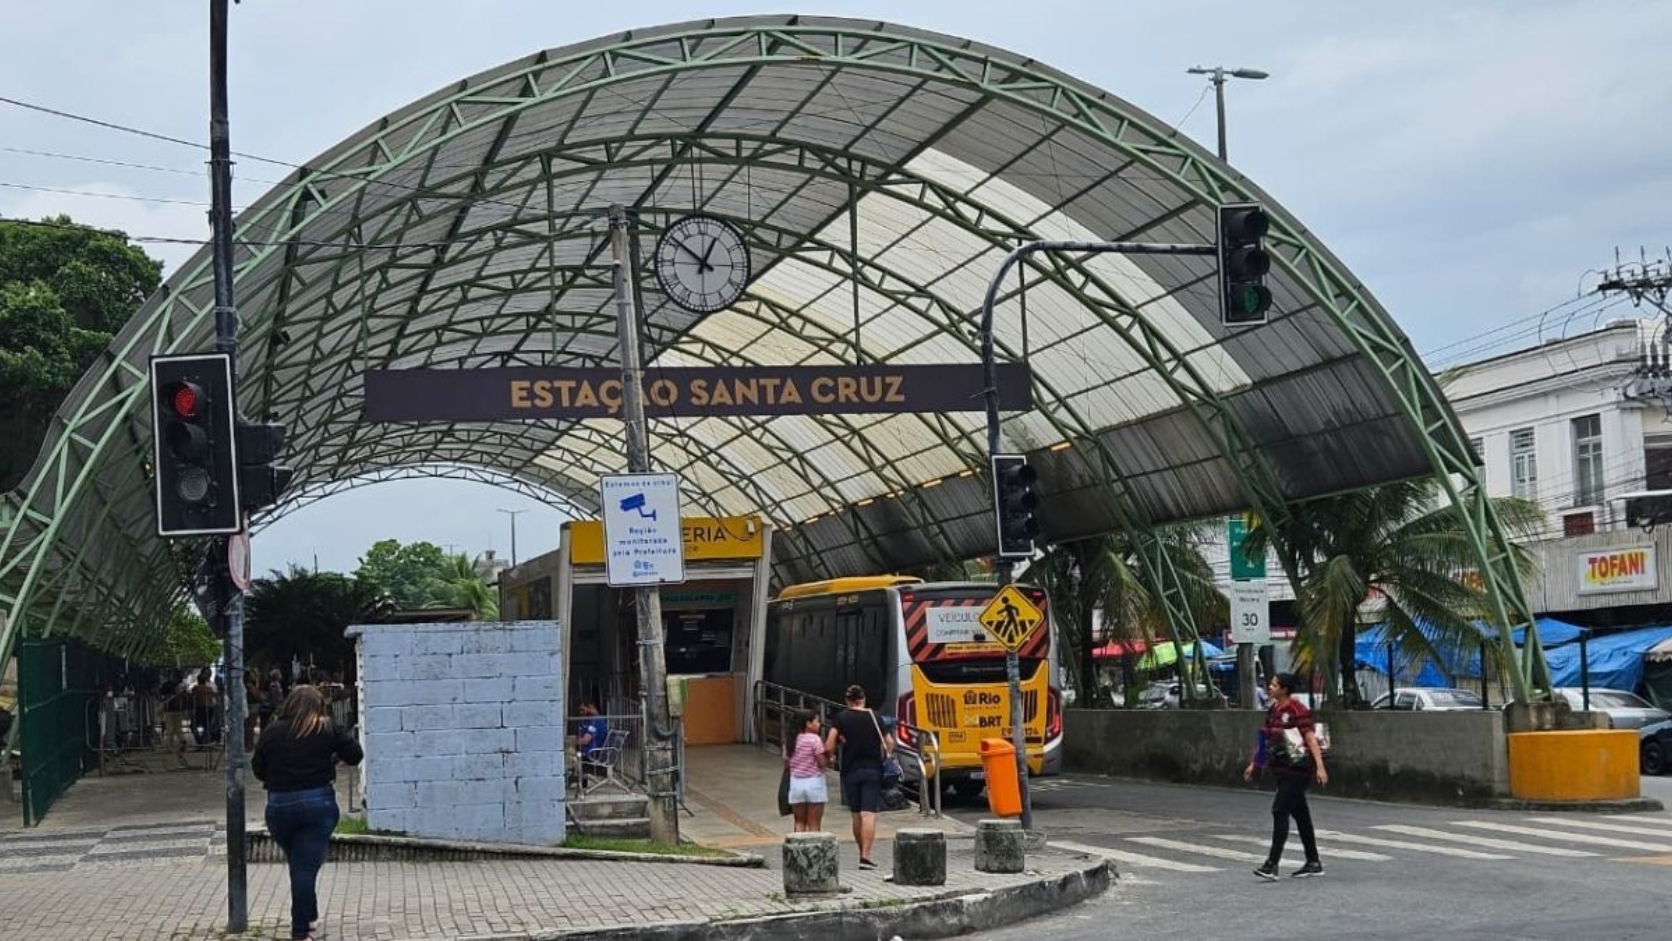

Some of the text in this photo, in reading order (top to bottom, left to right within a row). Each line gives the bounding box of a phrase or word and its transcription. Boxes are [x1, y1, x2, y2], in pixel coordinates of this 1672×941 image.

[511, 371, 905, 414] ESTAÇO SANTA CRUZ
[682, 526, 727, 543] ERIA
[1588, 551, 1645, 580] TOFANI
[1242, 612, 1258, 627] 30
[979, 692, 1001, 705] Rio
[979, 715, 1002, 728] BRT
